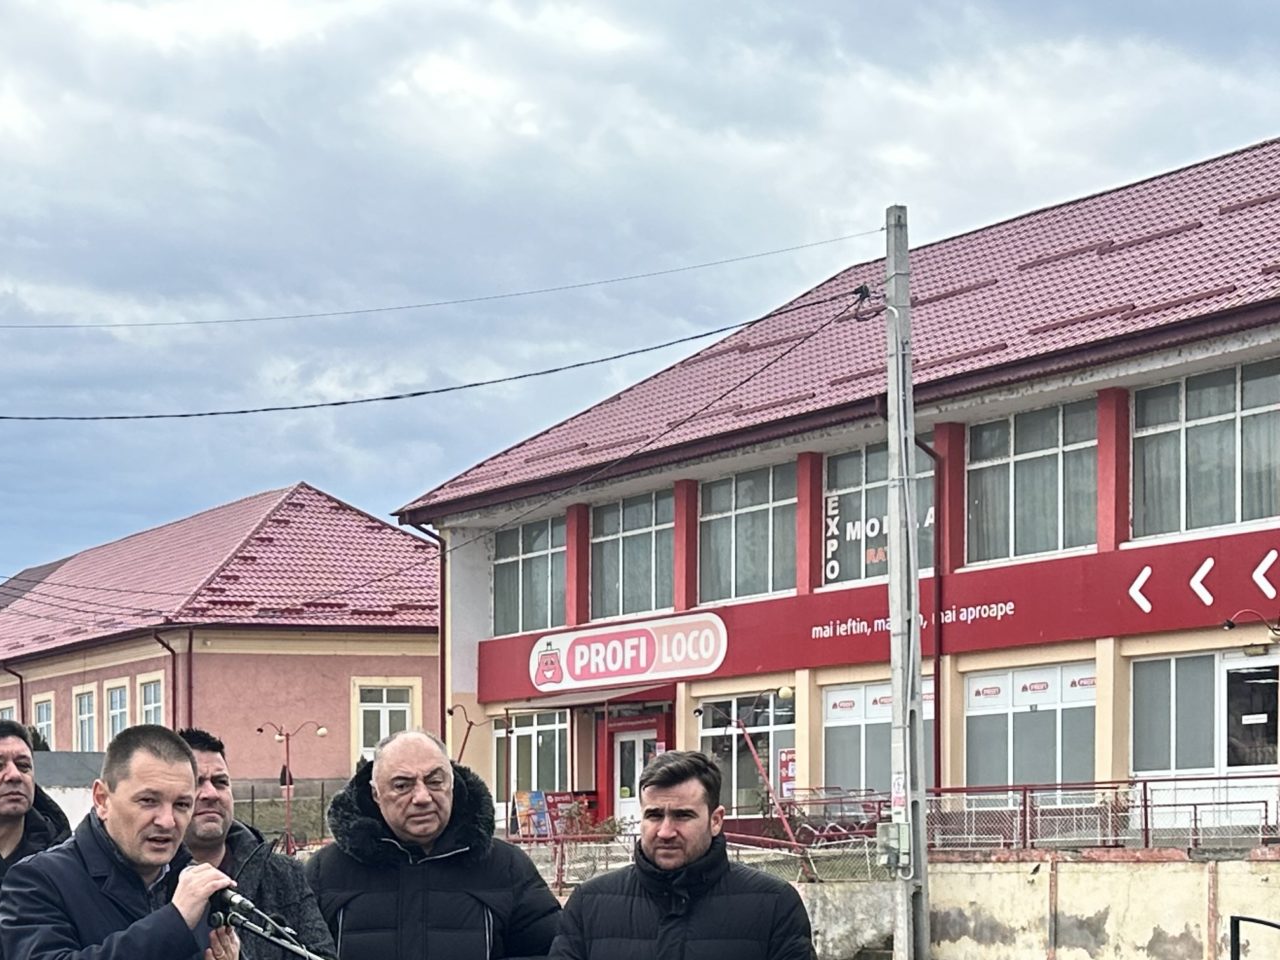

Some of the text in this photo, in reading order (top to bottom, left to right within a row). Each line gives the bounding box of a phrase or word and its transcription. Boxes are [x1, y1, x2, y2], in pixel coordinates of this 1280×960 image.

[826, 496, 840, 580] EXPO
[812, 620, 833, 639] mai
[836, 618, 872, 637] ieftin,
[874, 617, 892, 632] ma
[959, 601, 1015, 624] aproape
[574, 628, 716, 676] PROFI LOCO
